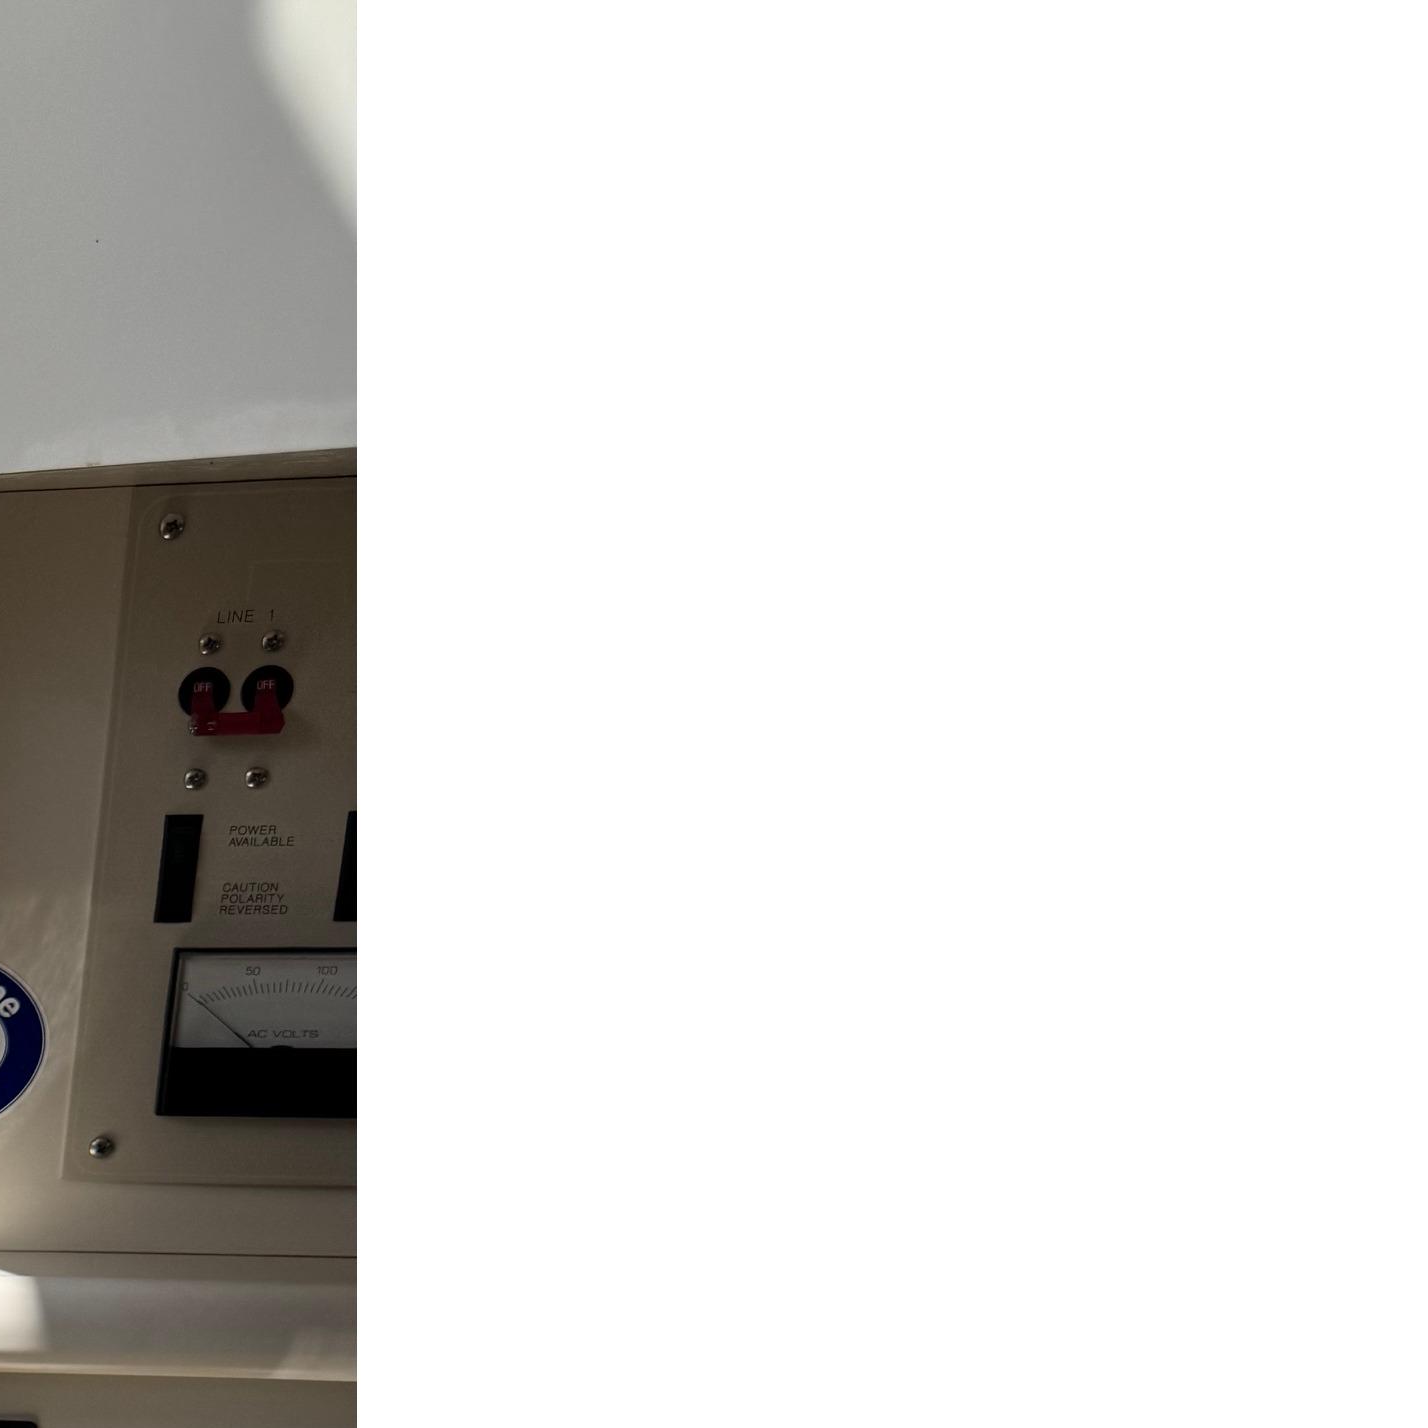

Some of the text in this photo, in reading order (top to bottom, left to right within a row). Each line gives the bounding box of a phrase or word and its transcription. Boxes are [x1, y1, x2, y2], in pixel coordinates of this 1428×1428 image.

[217, 609, 275, 624] LINE 1
[193, 682, 213, 693] OFF
[256, 680, 276, 690] OFF
[228, 824, 277, 836] POWER
[227, 835, 296, 847] AVAILABLE
[222, 882, 279, 893] CAUTION
[220, 893, 285, 904] POLARITY
[218, 904, 289, 915] REVERSED
[245, 966, 262, 976] 50
[316, 965, 338, 976] 100
[247, 1029, 320, 1039] AC VOLTS
